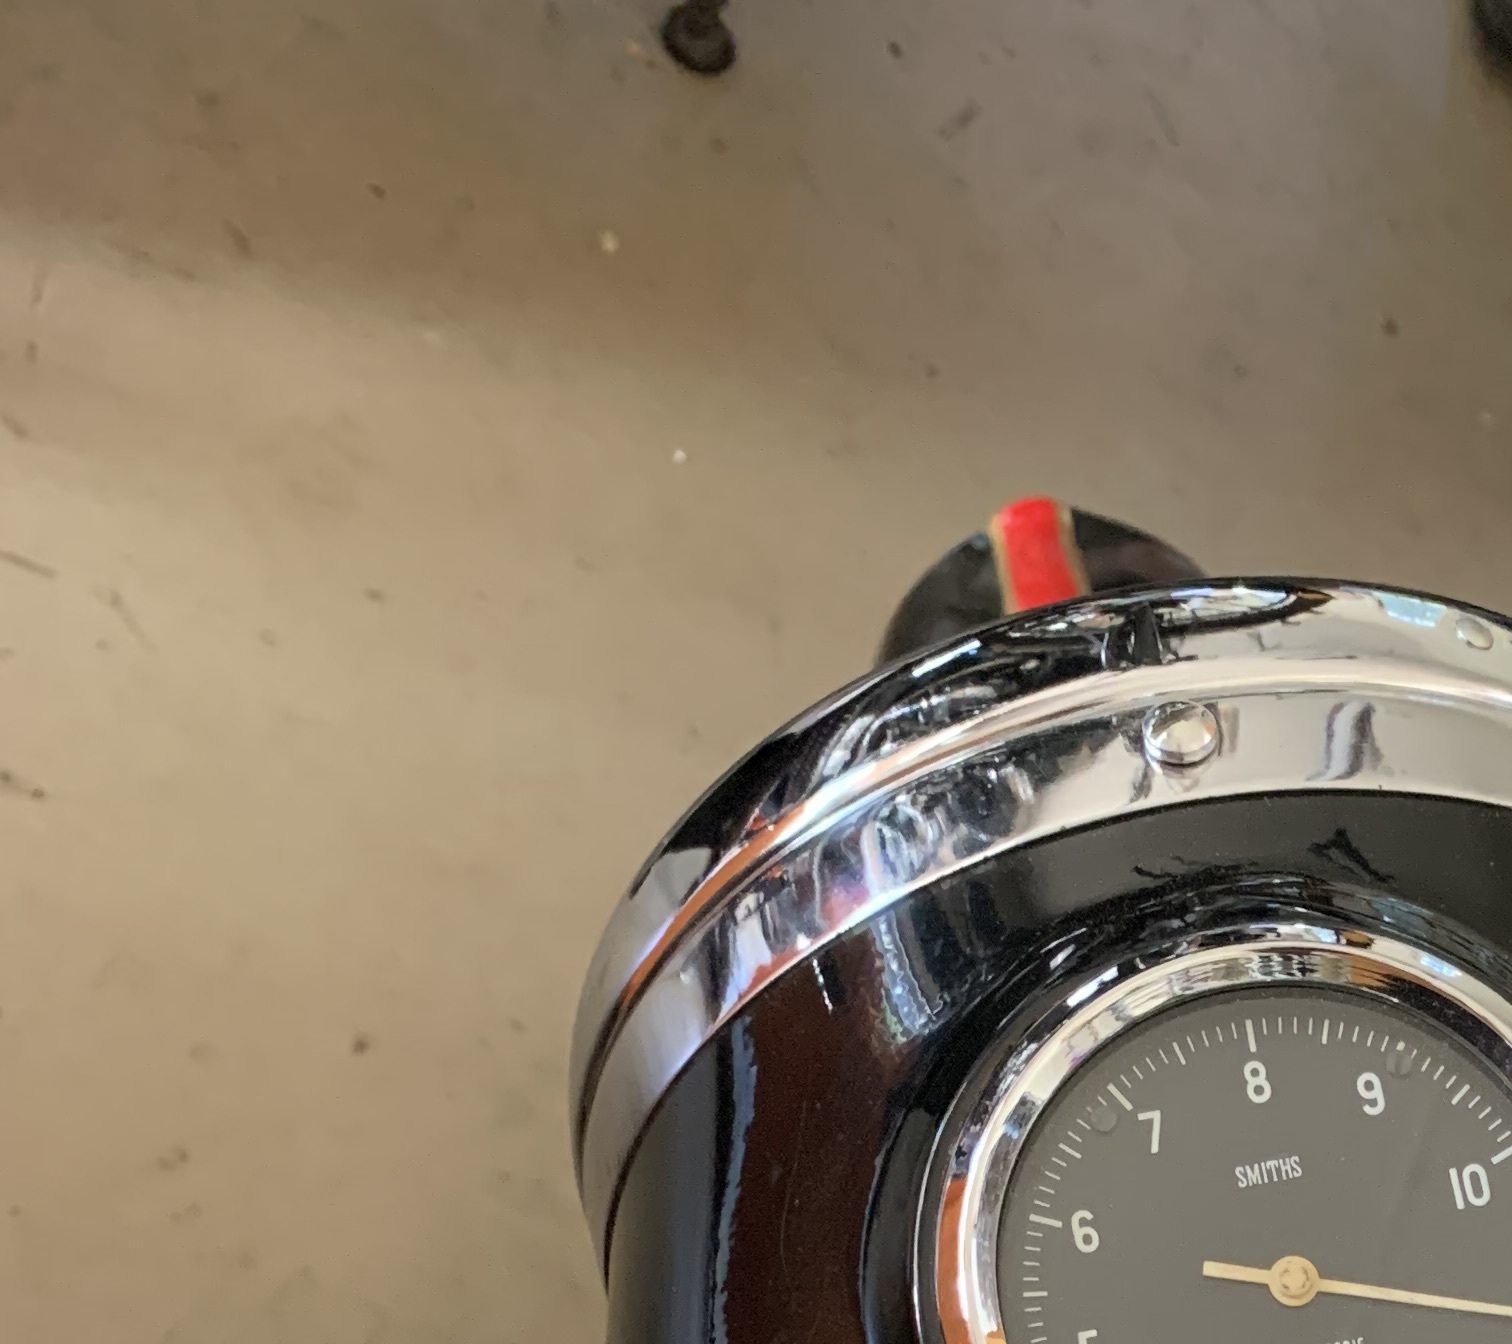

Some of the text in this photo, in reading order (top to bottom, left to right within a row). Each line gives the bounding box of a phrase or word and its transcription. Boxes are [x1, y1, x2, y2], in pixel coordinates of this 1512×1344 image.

[1244, 1061, 1271, 1104] 8
[1356, 1072, 1386, 1116] 9
[1137, 1110, 1163, 1154] 7
[1235, 1155, 1303, 1189] SMITHS
[1448, 1163, 1492, 1211] 10
[1070, 1210, 1100, 1253] 6
